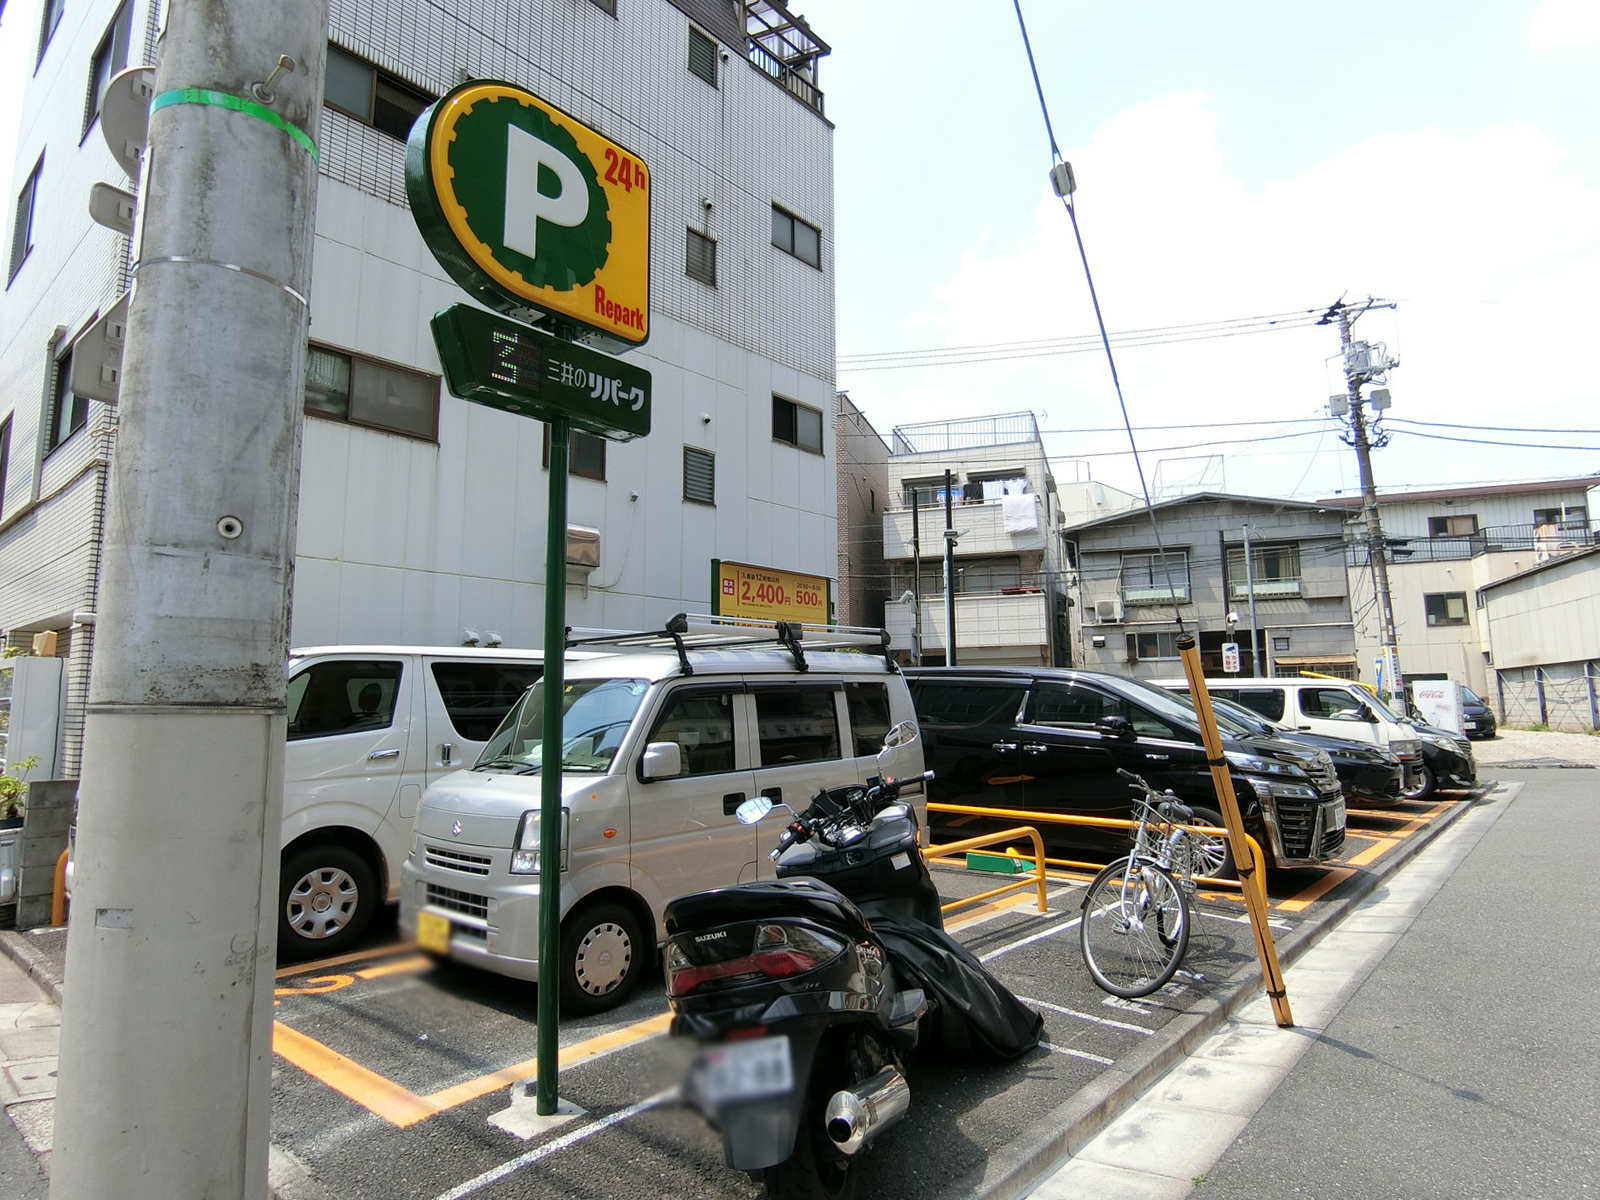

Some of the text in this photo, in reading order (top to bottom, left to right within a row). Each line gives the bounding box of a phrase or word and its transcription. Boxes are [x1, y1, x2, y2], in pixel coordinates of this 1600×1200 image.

[503, 122, 589, 260] P
[604, 147, 646, 193] 24h
[594, 284, 644, 333] Repark
[547, 357, 645, 413] 三井のリパーク
[695, 930, 727, 943] SUZUKI
